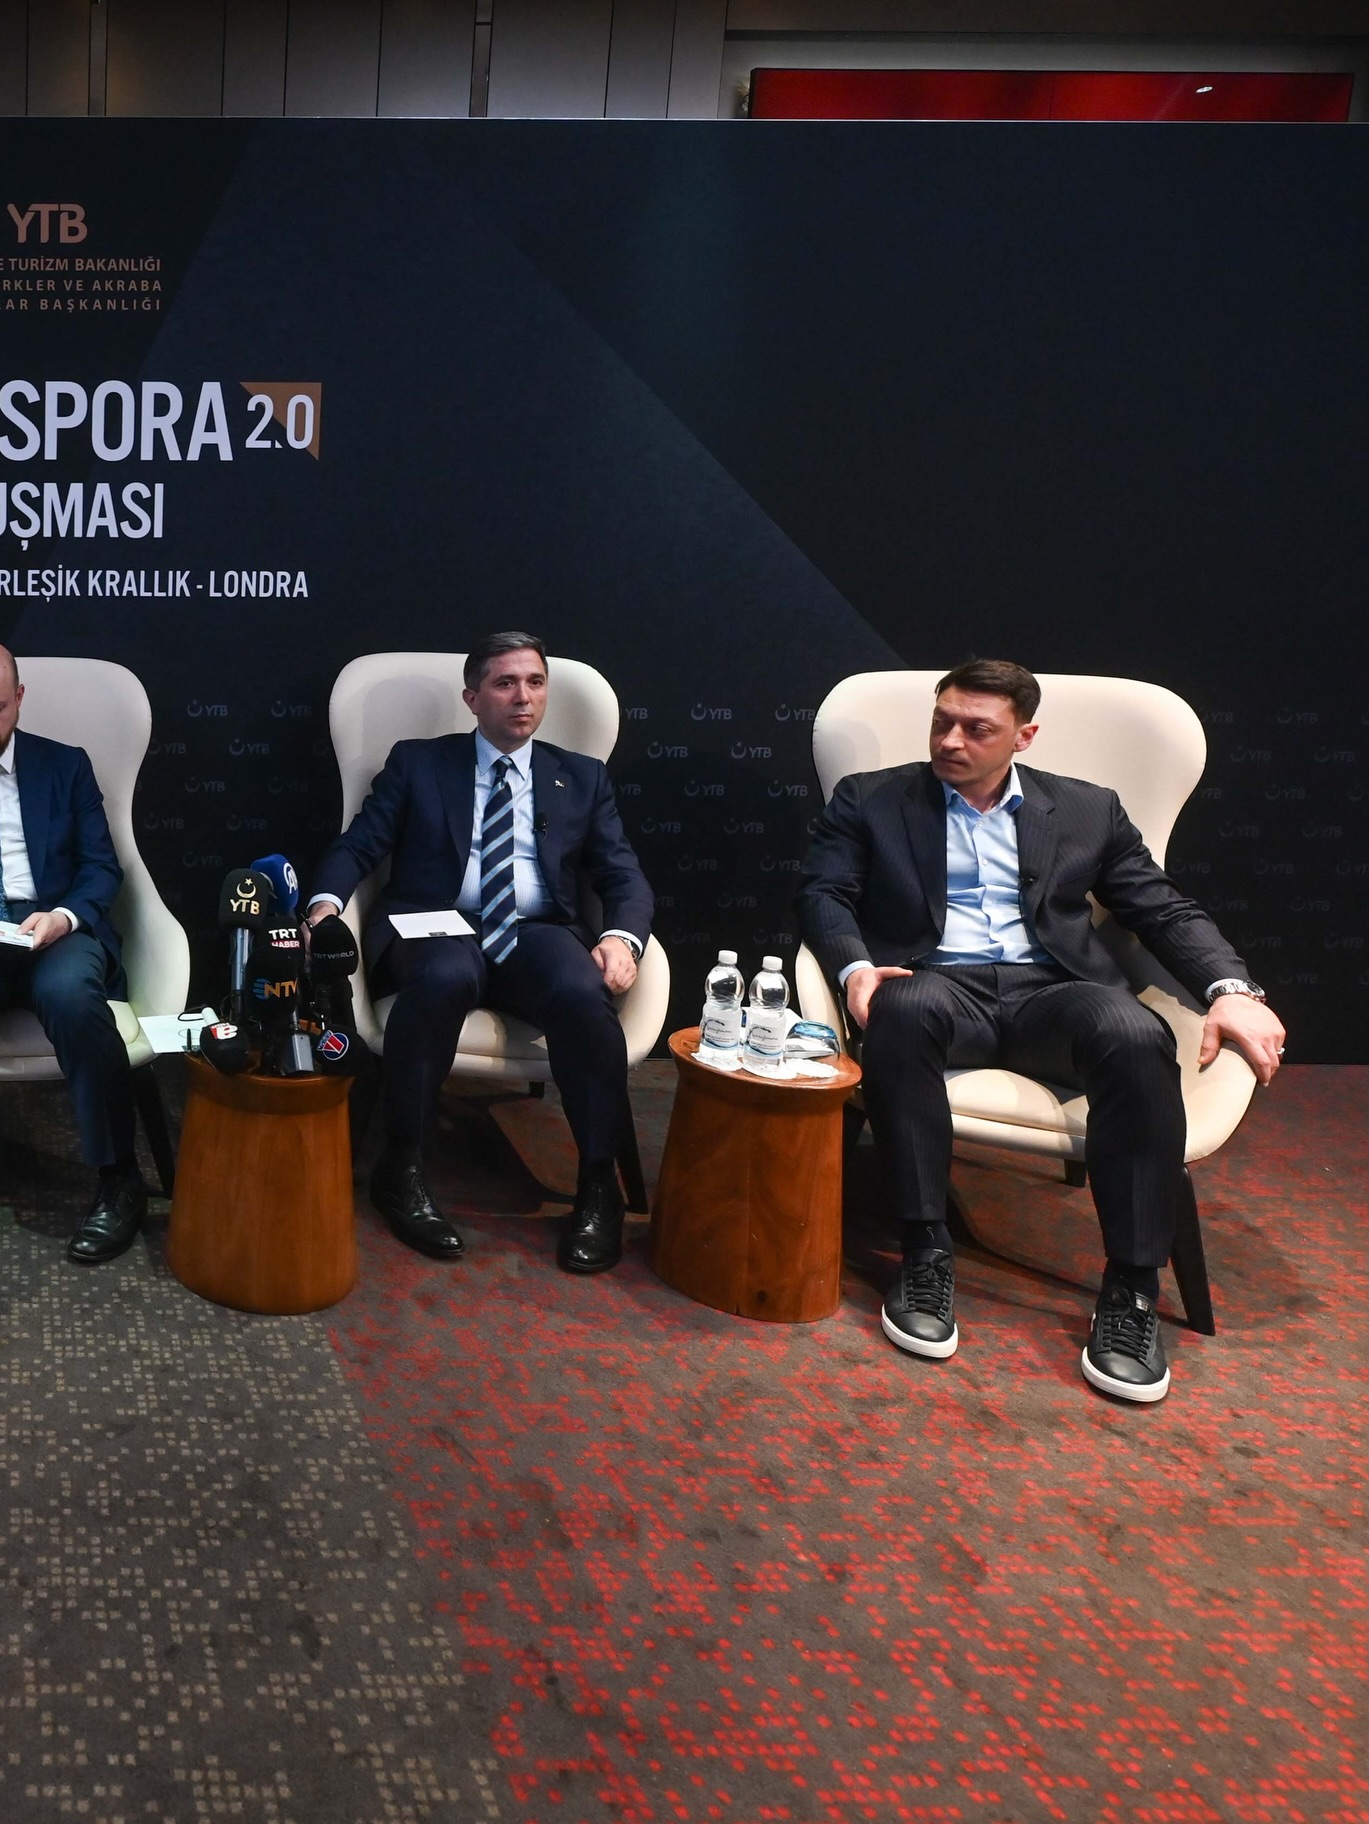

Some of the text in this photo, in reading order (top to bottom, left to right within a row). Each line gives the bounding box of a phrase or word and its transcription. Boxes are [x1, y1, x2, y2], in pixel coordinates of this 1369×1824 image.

[7, 203, 88, 244] YTB
[8, 255, 69, 271] TURİZM
[75, 255, 161, 272] BAKANLIĞI
[63, 279, 84, 291] VE
[91, 279, 162, 292] AKRABA
[39, 296, 160, 313] BAŞKANLIĞI
[245, 394, 315, 450] 2.0
[87, 569, 191, 597] KRALLIK
[209, 570, 309, 598] LONDRA
[205, 705, 229, 717] YTB
[289, 705, 312, 717] YTB
[625, 708, 648, 720] YTB
[709, 708, 732, 720] YTB
[794, 708, 815, 721] YTB
[1211, 712, 1234, 724] YTB
[1296, 712, 1318, 724] YTB
[163, 743, 186, 755] YTB
[247, 743, 270, 755] YTB
[665, 746, 688, 758] YTB
[749, 747, 772, 759] YTB
[1249, 750, 1272, 762] YTB
[1333, 751, 1356, 763] YTB
[203, 781, 226, 793] YTB
[619, 784, 642, 796] YTB
[702, 784, 725, 796] YTB
[785, 785, 808, 797] YTB
[1201, 788, 1222, 800] YTB
[1284, 789, 1306, 800] YTB
[162, 818, 184, 830] YTB
[659, 822, 682, 833] YTB
[742, 822, 765, 834] YTB
[1237, 826, 1260, 838] YTB
[1321, 826, 1343, 838] YTB
[695, 859, 718, 871] YTB
[778, 860, 801, 872] YTB
[1189, 862, 1211, 874] YTB
[1272, 863, 1294, 875] YTB
[1354, 864, 1369, 875] YT
[230, 898, 260, 915] YTB
[1308, 900, 1331, 912] YTB
[268, 928, 298, 941] TRT
[264, 978, 298, 998] NTV
